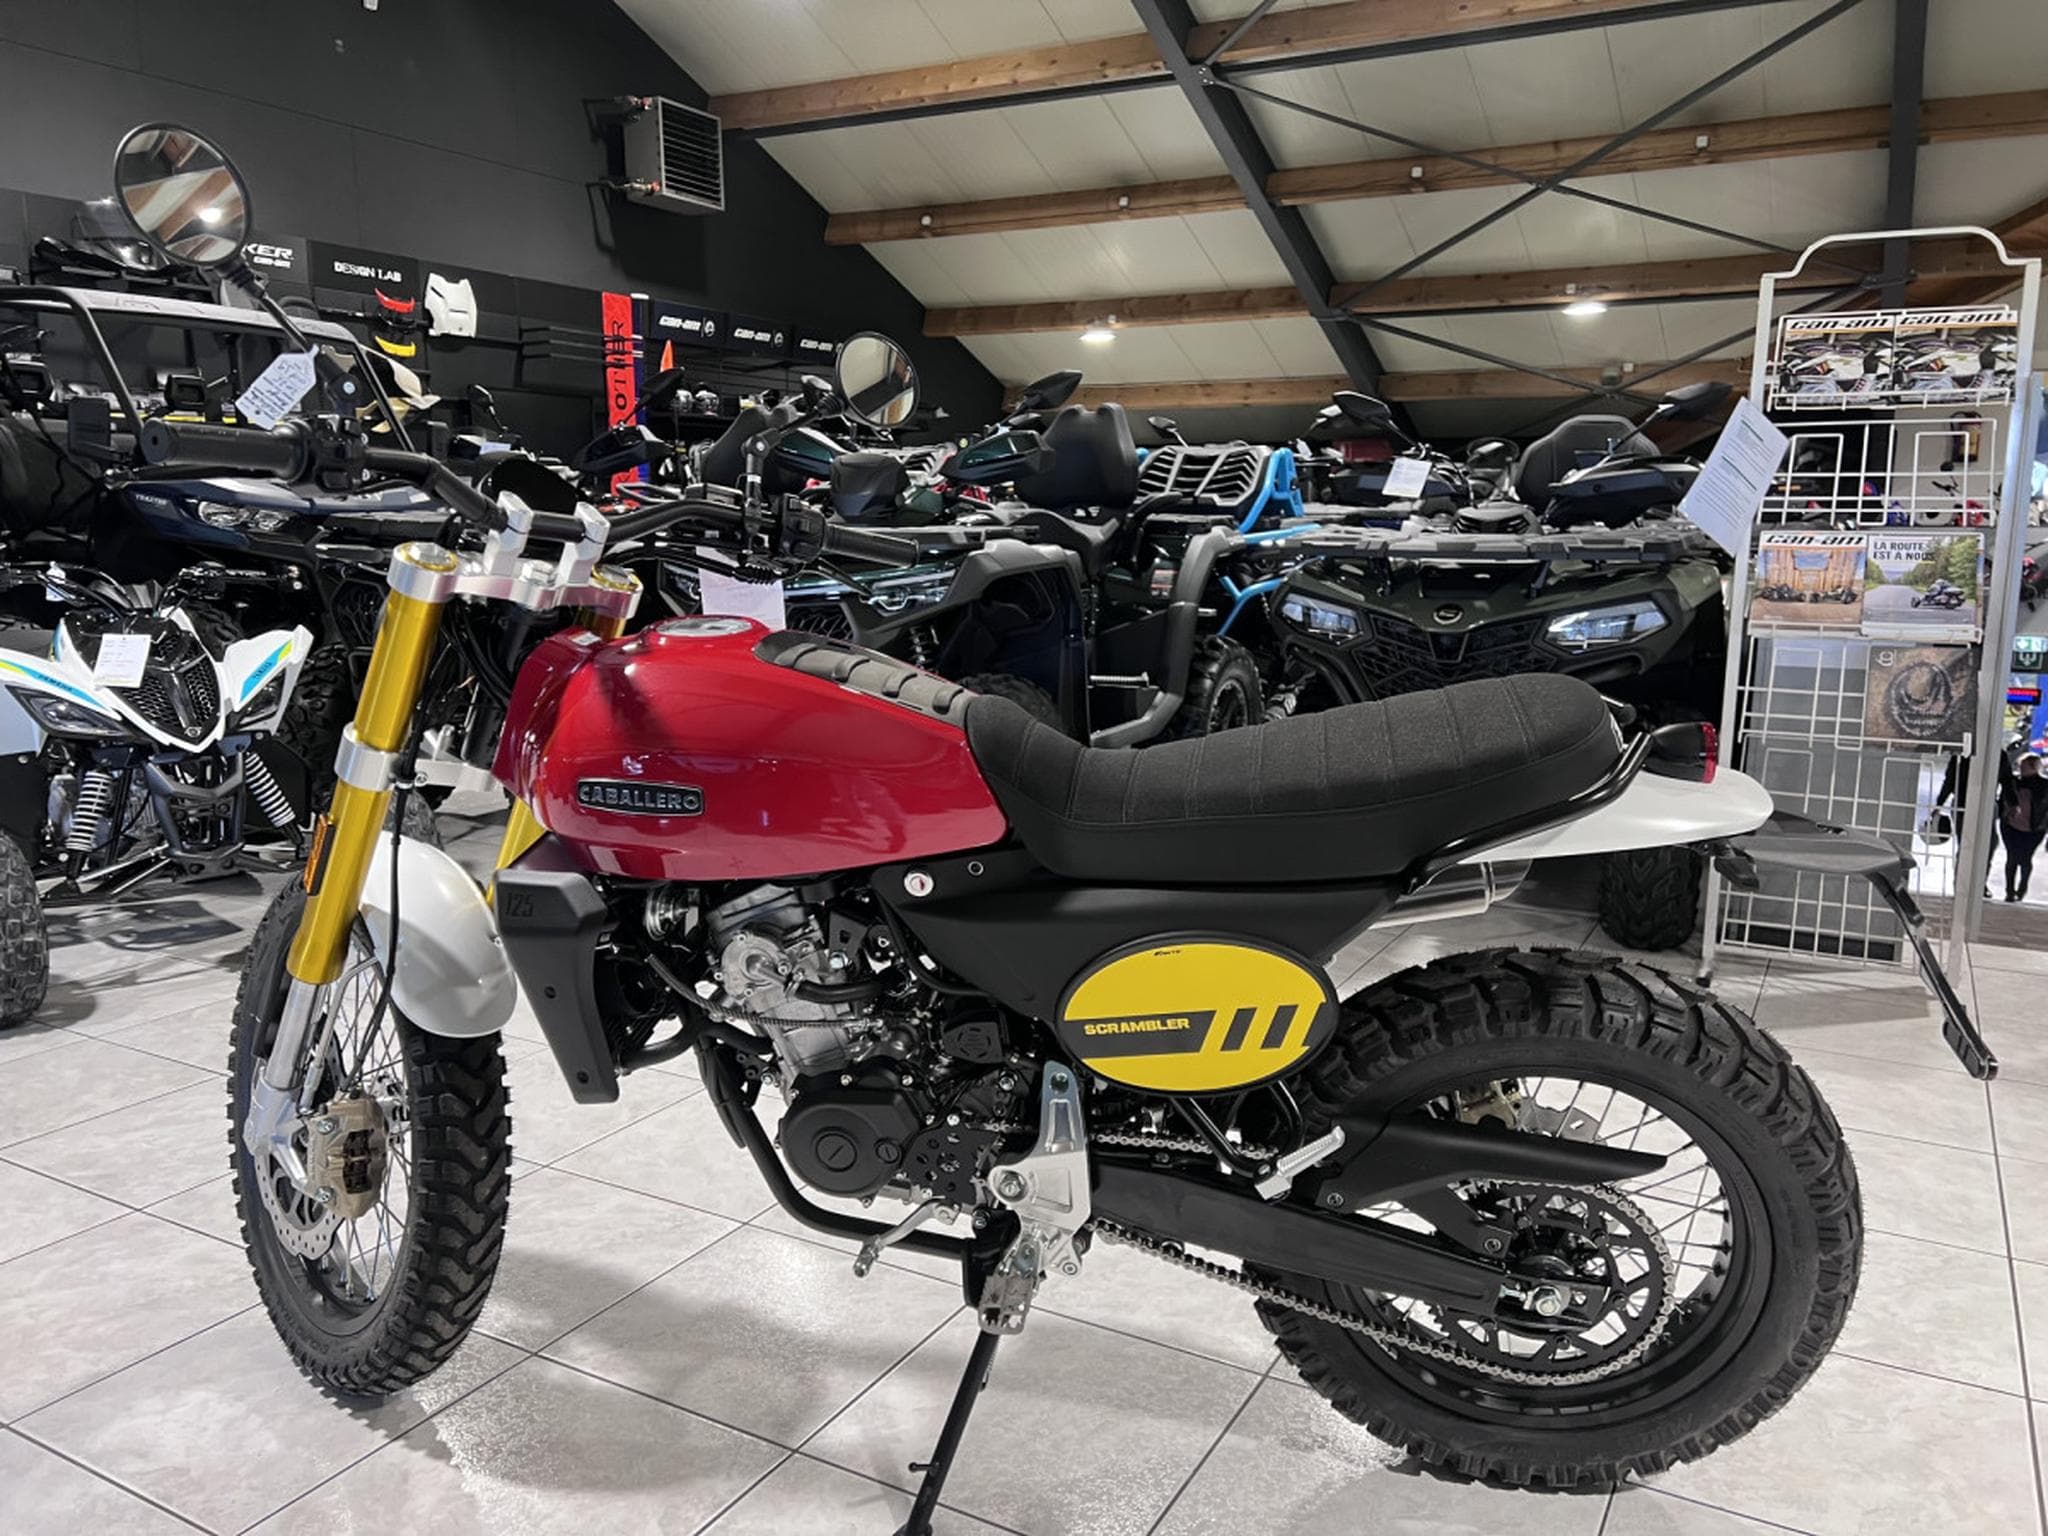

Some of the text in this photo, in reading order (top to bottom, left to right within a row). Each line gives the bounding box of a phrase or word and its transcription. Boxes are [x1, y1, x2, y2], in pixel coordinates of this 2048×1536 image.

[334, 261, 402, 282] DESIGN LAB
[1873, 541, 1926, 551] LA ROUTE
[1873, 551, 1891, 560] EST
[579, 785, 700, 810] CABALLERO
[506, 893, 534, 918] 125
[1084, 1018, 1191, 1036] SCRAMBLER
